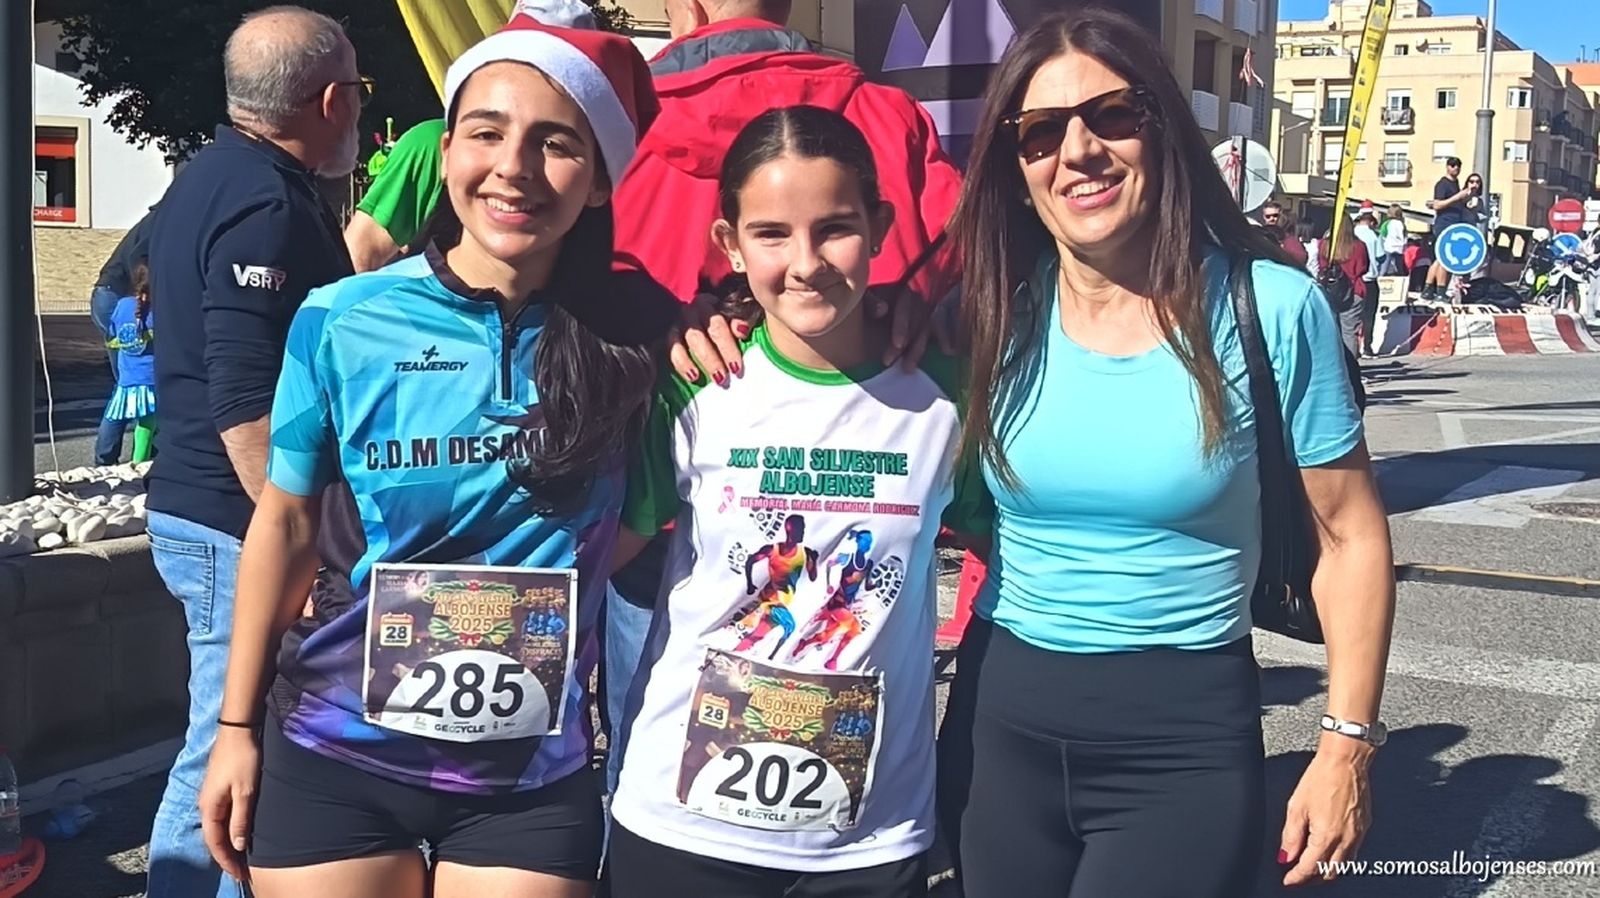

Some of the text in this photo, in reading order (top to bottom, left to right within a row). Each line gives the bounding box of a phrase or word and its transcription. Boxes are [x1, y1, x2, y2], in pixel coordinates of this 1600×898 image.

[394, 361, 469, 373] TEAMERGY
[365, 426, 549, 471] C.D.M DESAM
[727, 446, 908, 476] XIX SAN SILVESTRE
[759, 471, 875, 498] ALBOJENSE
[740, 496, 789, 509] MEMORIAL
[824, 500, 871, 513] CARMONA
[435, 602, 511, 617] ALBOJENSE
[386, 626, 408, 640] 28
[450, 617, 493, 632] 2025
[408, 662, 525, 718] 285
[704, 705, 724, 721] 28
[751, 695, 823, 717] ALBOJENSE
[763, 710, 803, 729] 2025
[715, 746, 828, 809] 202
